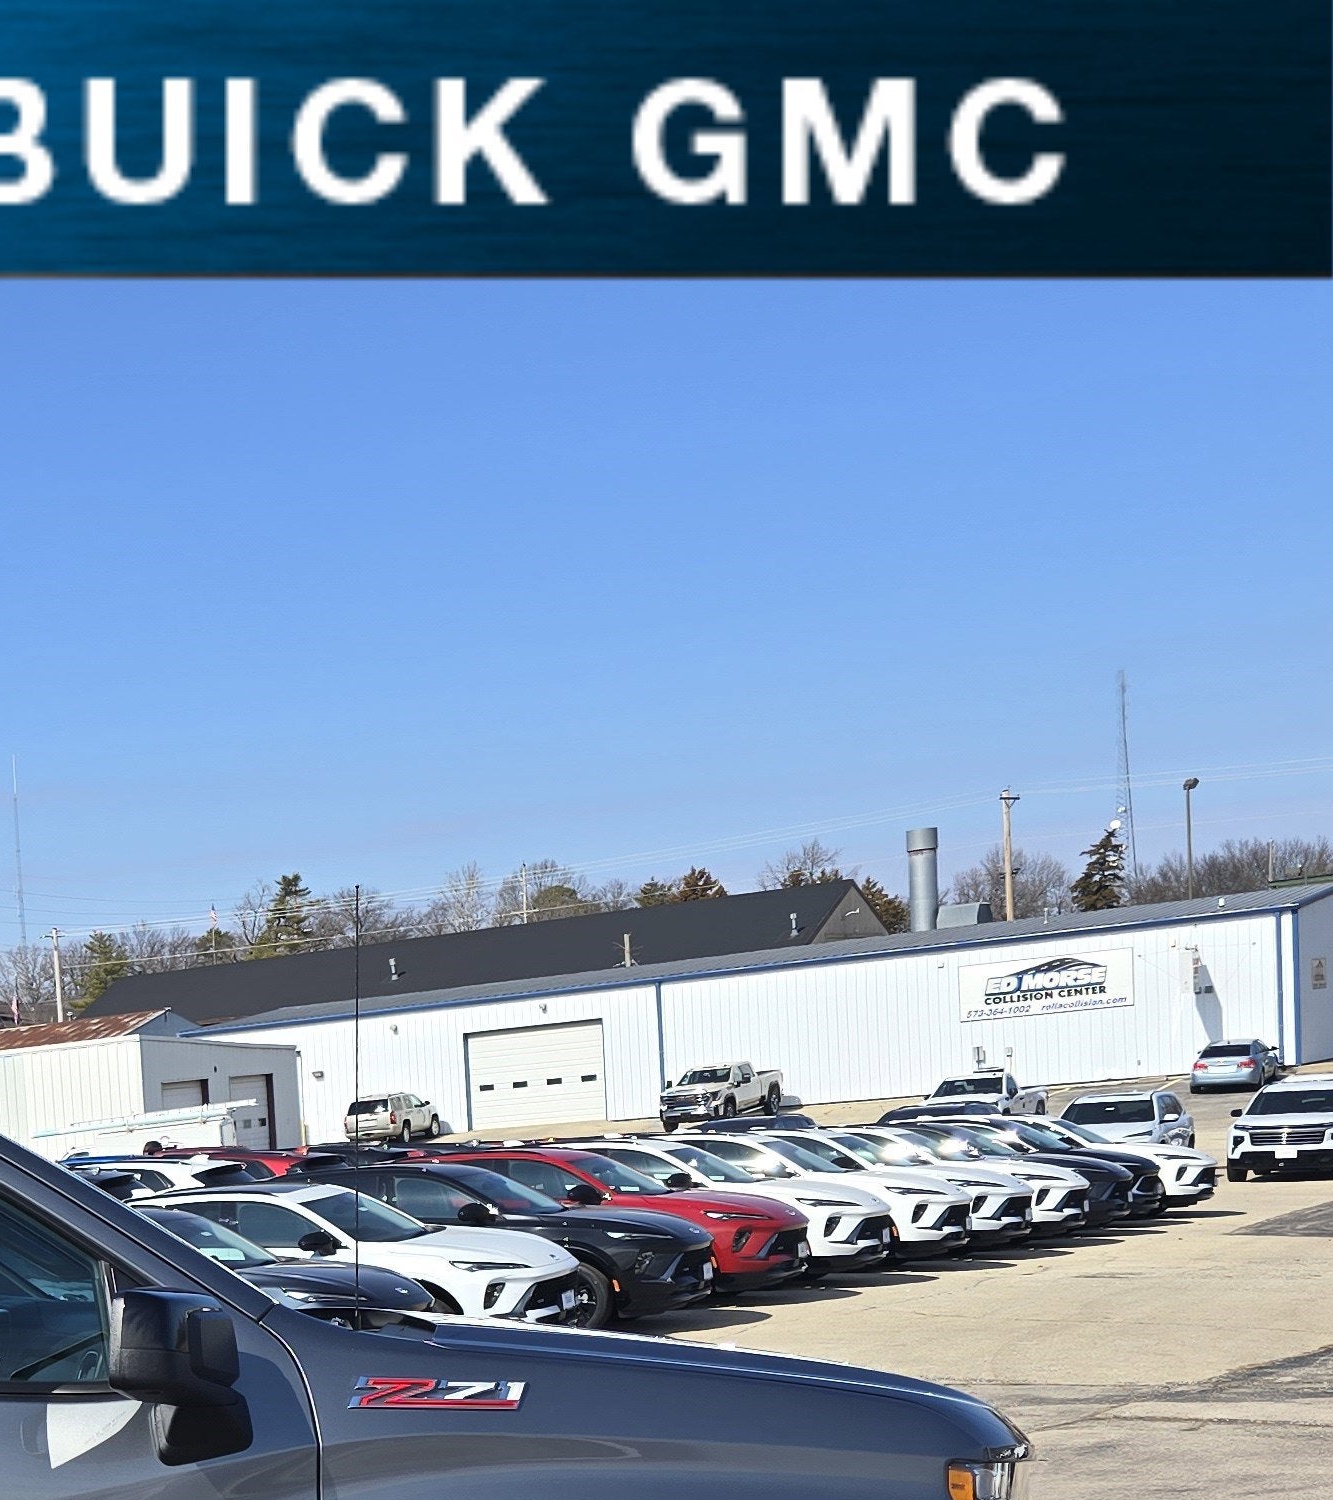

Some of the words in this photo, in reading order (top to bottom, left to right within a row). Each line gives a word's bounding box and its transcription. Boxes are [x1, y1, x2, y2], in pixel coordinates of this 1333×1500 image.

[985, 976, 1019, 996] ED
[1020, 965, 1108, 993] MORSE
[984, 990, 1054, 1006] COLLISION
[1058, 985, 1107, 999] CENTER
[1040, 996, 1128, 1012] rollacollision.com
[347, 1375, 528, 1411] Z71
